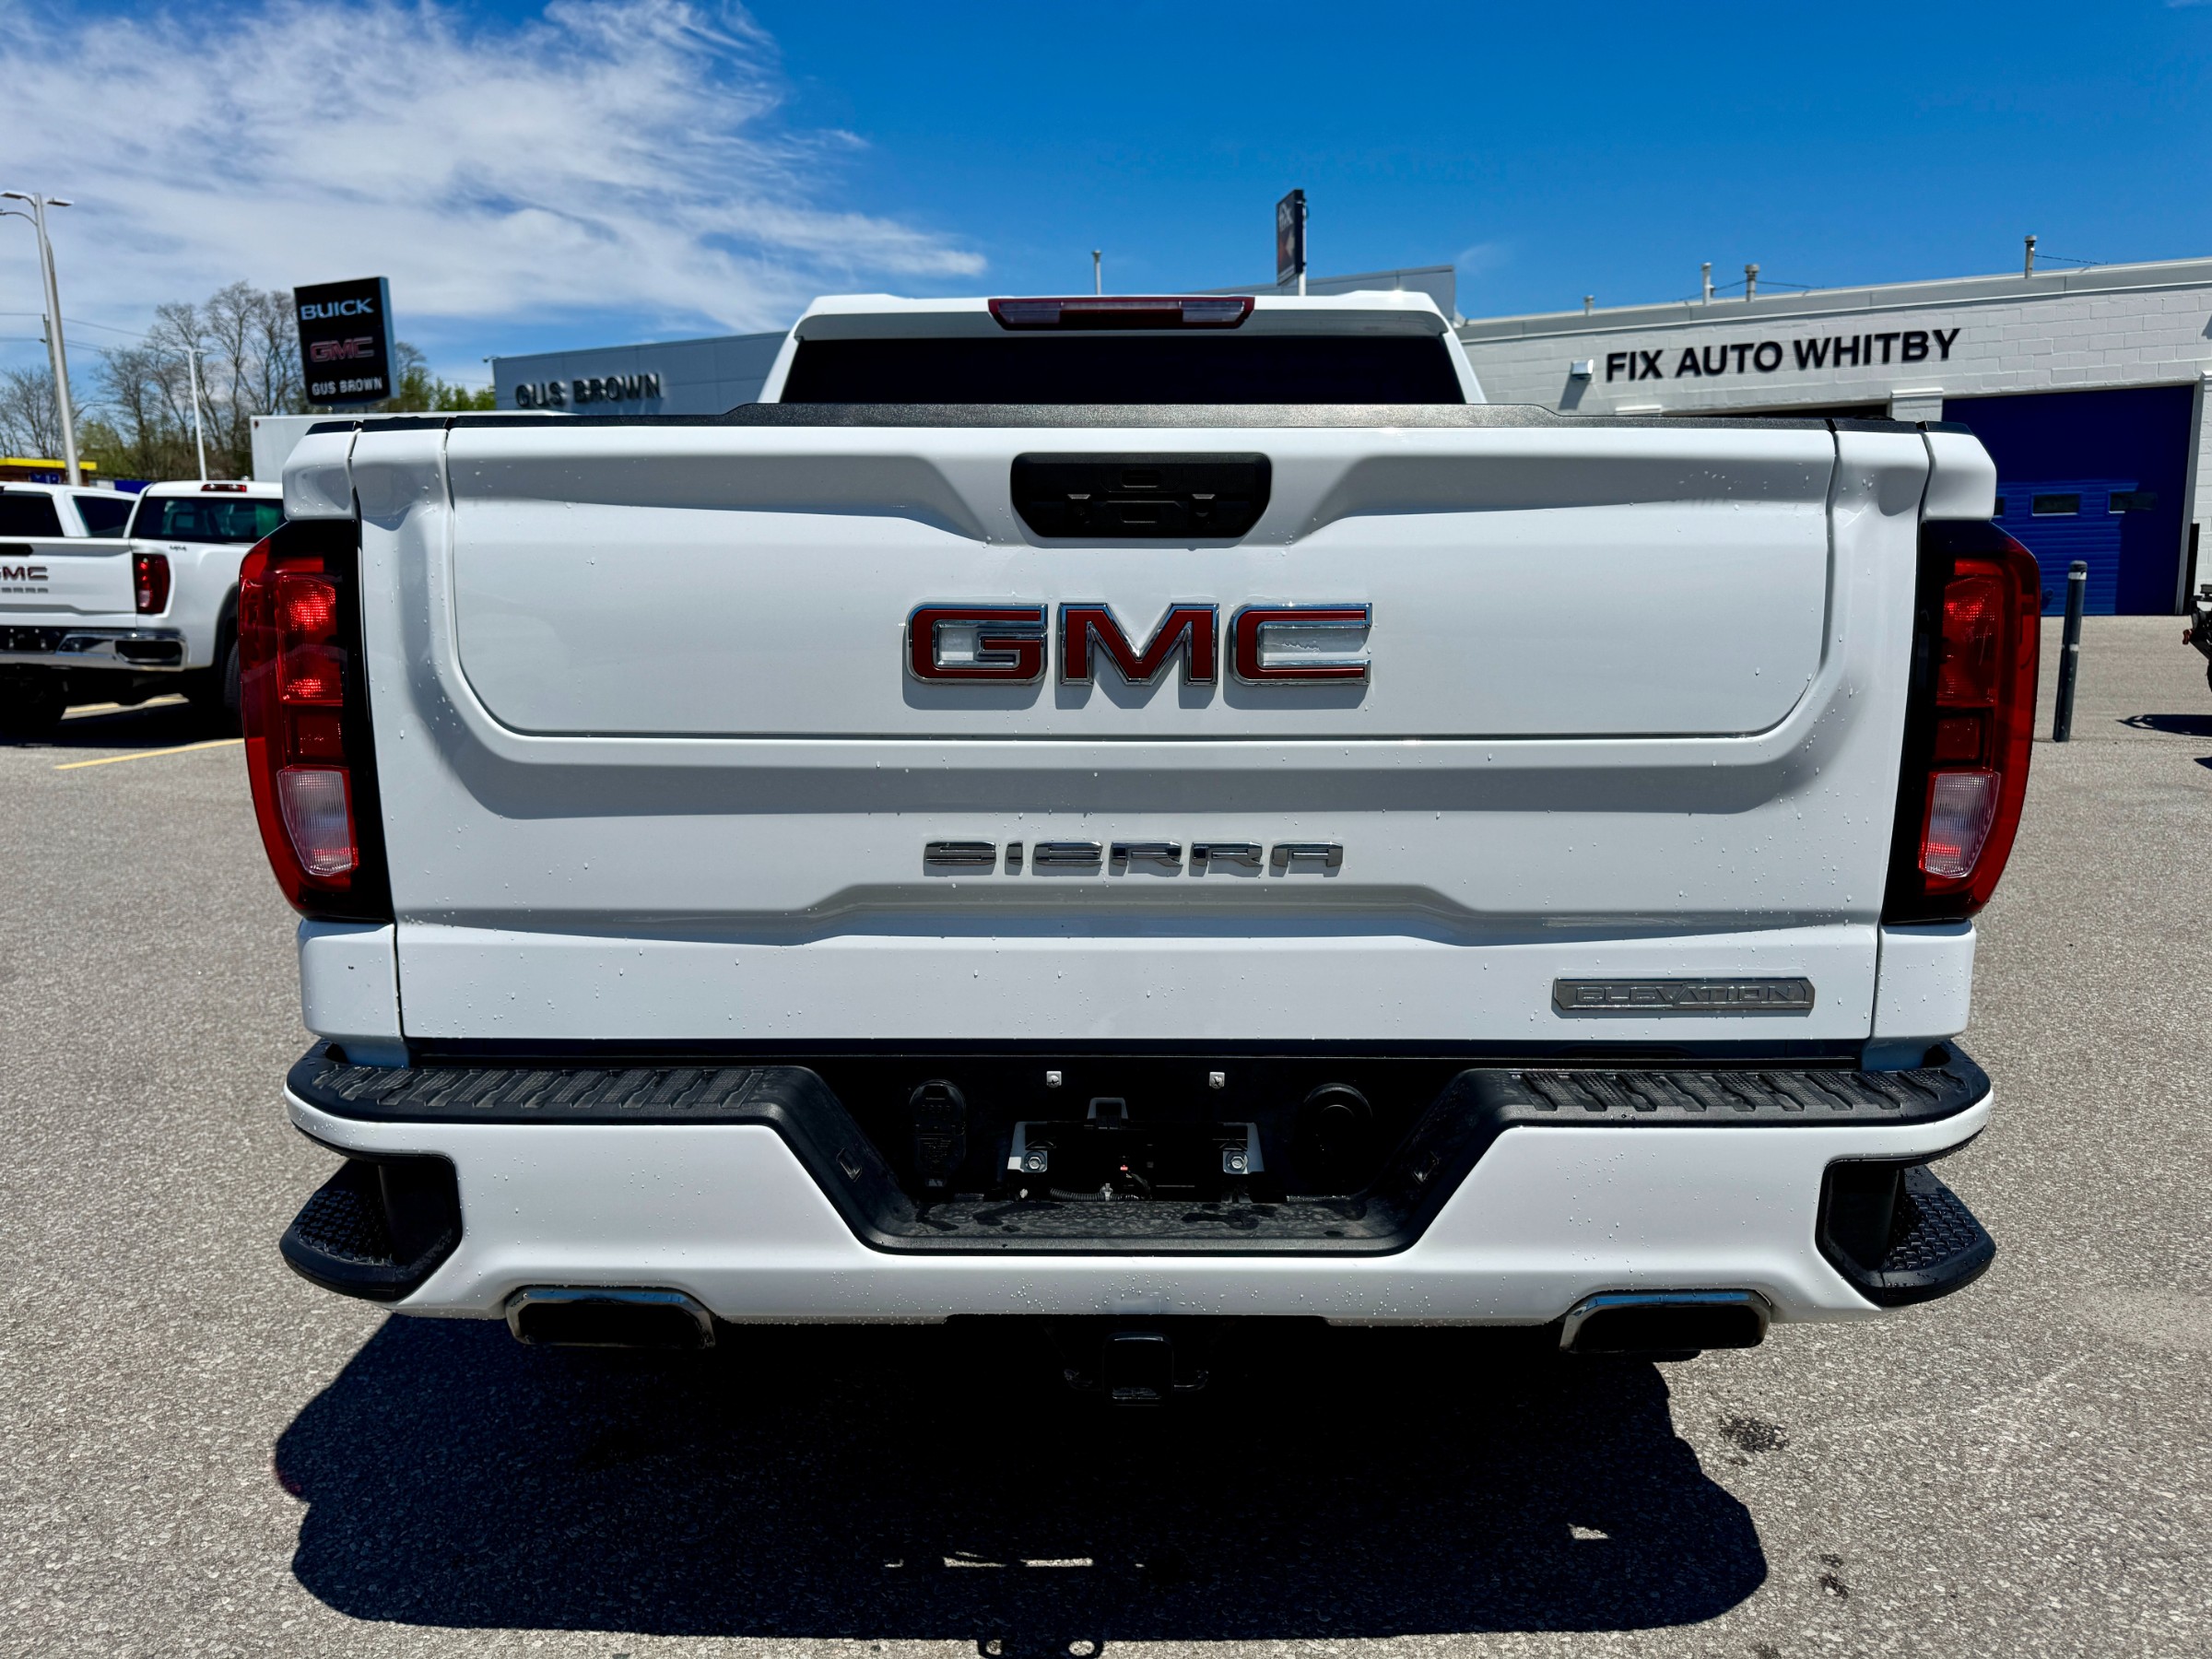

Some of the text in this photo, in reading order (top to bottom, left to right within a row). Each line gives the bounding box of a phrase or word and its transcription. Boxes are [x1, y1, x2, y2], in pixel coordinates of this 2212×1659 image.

[300, 298, 374, 321] BUICK
[310, 335, 375, 362] GMC
[1606, 328, 1961, 383] FIX AUTO WHITBY
[312, 376, 383, 396] GUS BROWN
[515, 371, 663, 407] GUS BROWN
[0, 566, 49, 581] MC
[906, 602, 1372, 687] GMC
[924, 841, 1343, 868] SIERRA
[1575, 983, 1796, 1004] ELEVATION
